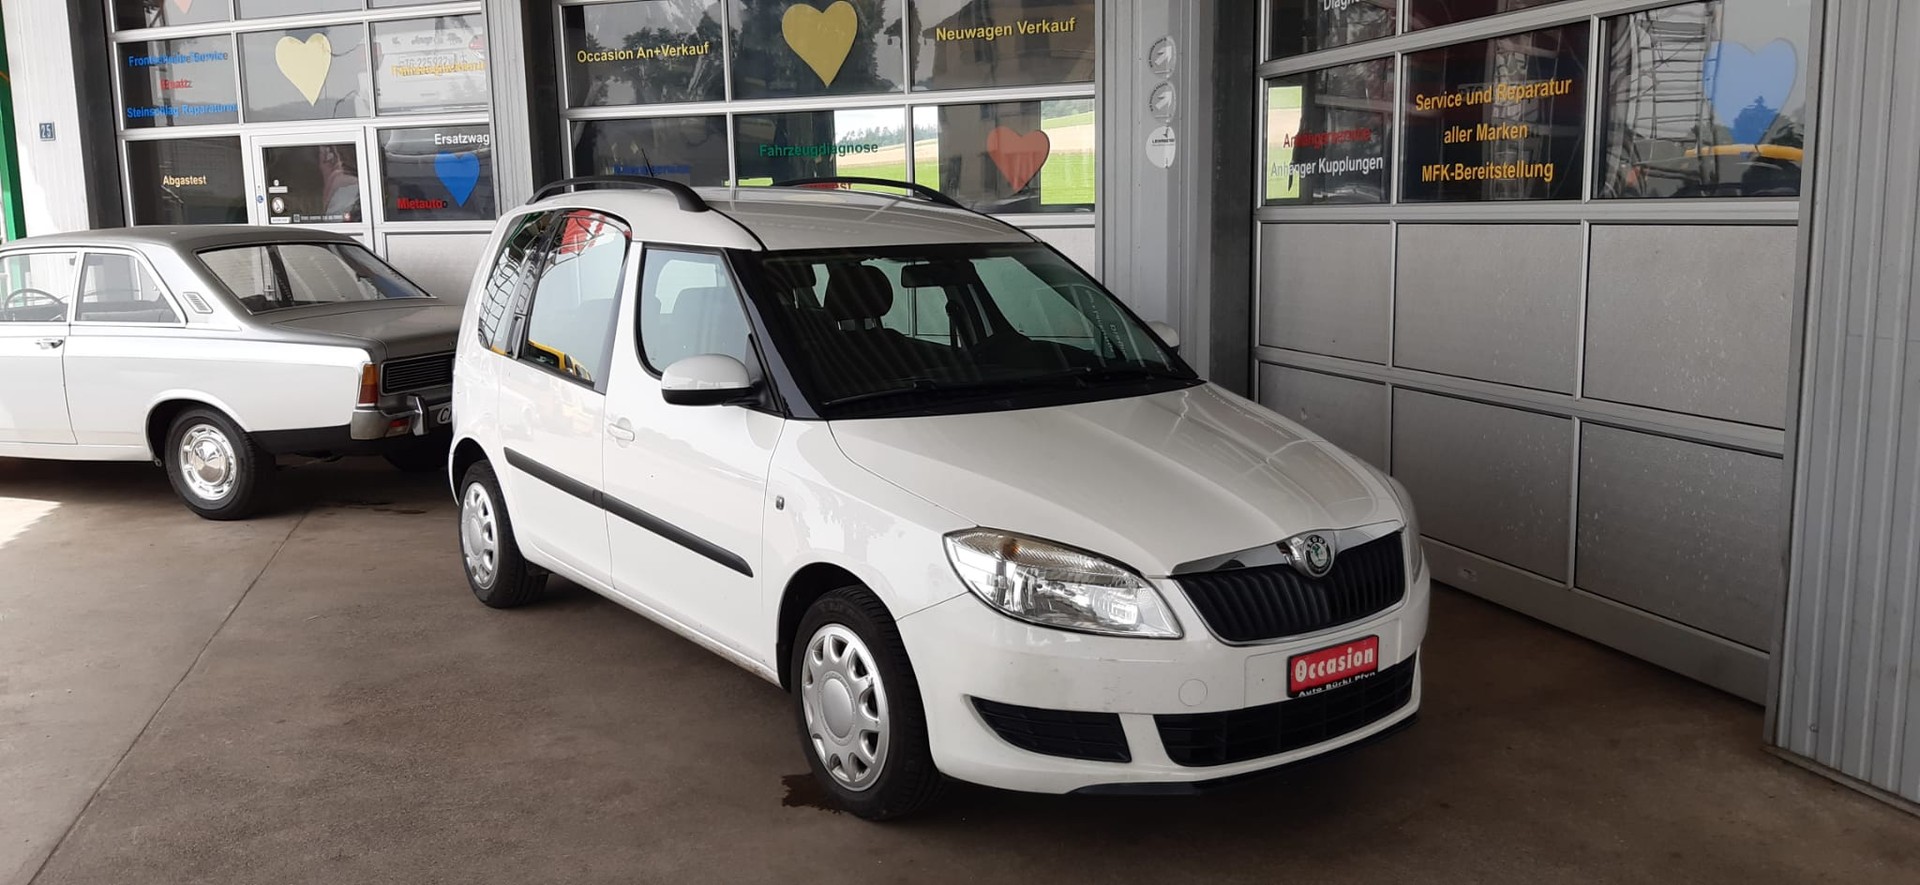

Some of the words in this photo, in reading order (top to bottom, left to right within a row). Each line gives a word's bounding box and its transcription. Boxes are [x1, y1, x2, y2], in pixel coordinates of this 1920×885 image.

[935, 24, 1013, 42] Neuwagen
[1016, 17, 1076, 35] Verkauf
[576, 48, 634, 62] Occasion
[636, 41, 709, 59] An+Verkauf
[1415, 91, 1462, 111] Service
[1466, 85, 1492, 106] und
[1496, 78, 1572, 104] Reparatur
[127, 105, 179, 118] Steinschlag
[41, 124, 52, 138] 25
[1444, 126, 1473, 143] aller
[1476, 122, 1528, 141] Marken
[759, 143, 878, 157] Fahrzeugdiagnose
[1318, 156, 1383, 176] Kupplungen
[1422, 160, 1554, 183] MFK-Bereitstellung
[163, 175, 207, 187] Abgastest
[1295, 647, 1374, 683] Occasion
[1298, 687, 1323, 698] Auto
